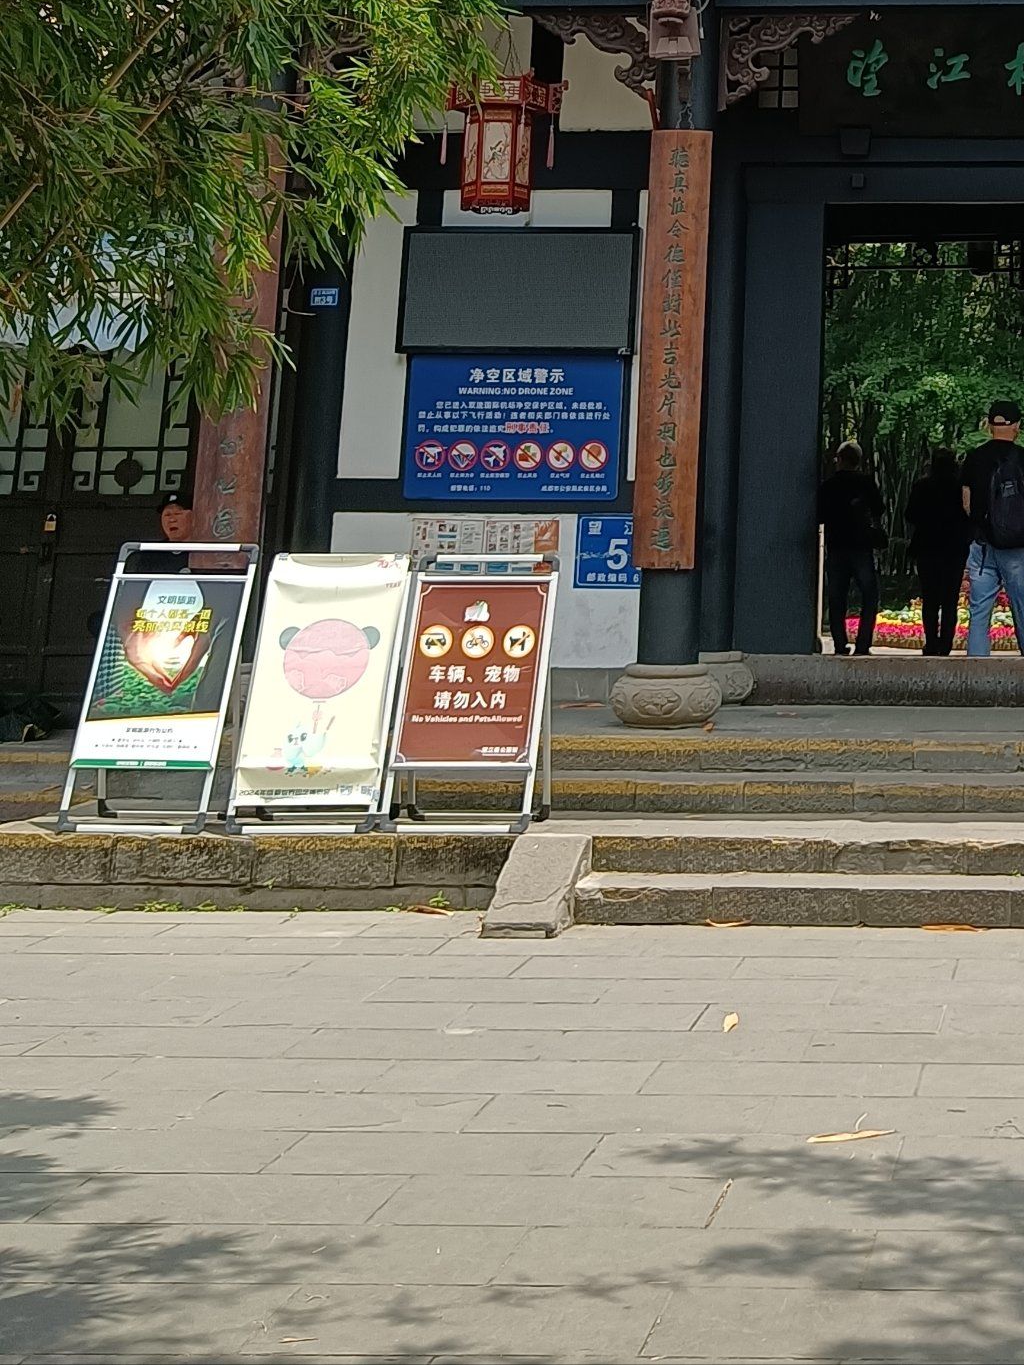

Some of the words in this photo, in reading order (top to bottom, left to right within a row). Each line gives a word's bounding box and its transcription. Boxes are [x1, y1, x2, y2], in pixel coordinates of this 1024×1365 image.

[469, 367, 565, 383] 净空区域警示
[518, 387, 549, 395] DRONE
[549, 387, 575, 395] ZONE
[606, 538, 628, 570] 5
[586, 573, 628, 583] 邮政编码
[428, 664, 521, 683] 车辆、宠物
[433, 690, 507, 710] 请勿入内
[411, 715, 424, 723] No
[424, 714, 458, 723] Vehicles
[458, 715, 473, 723] and
